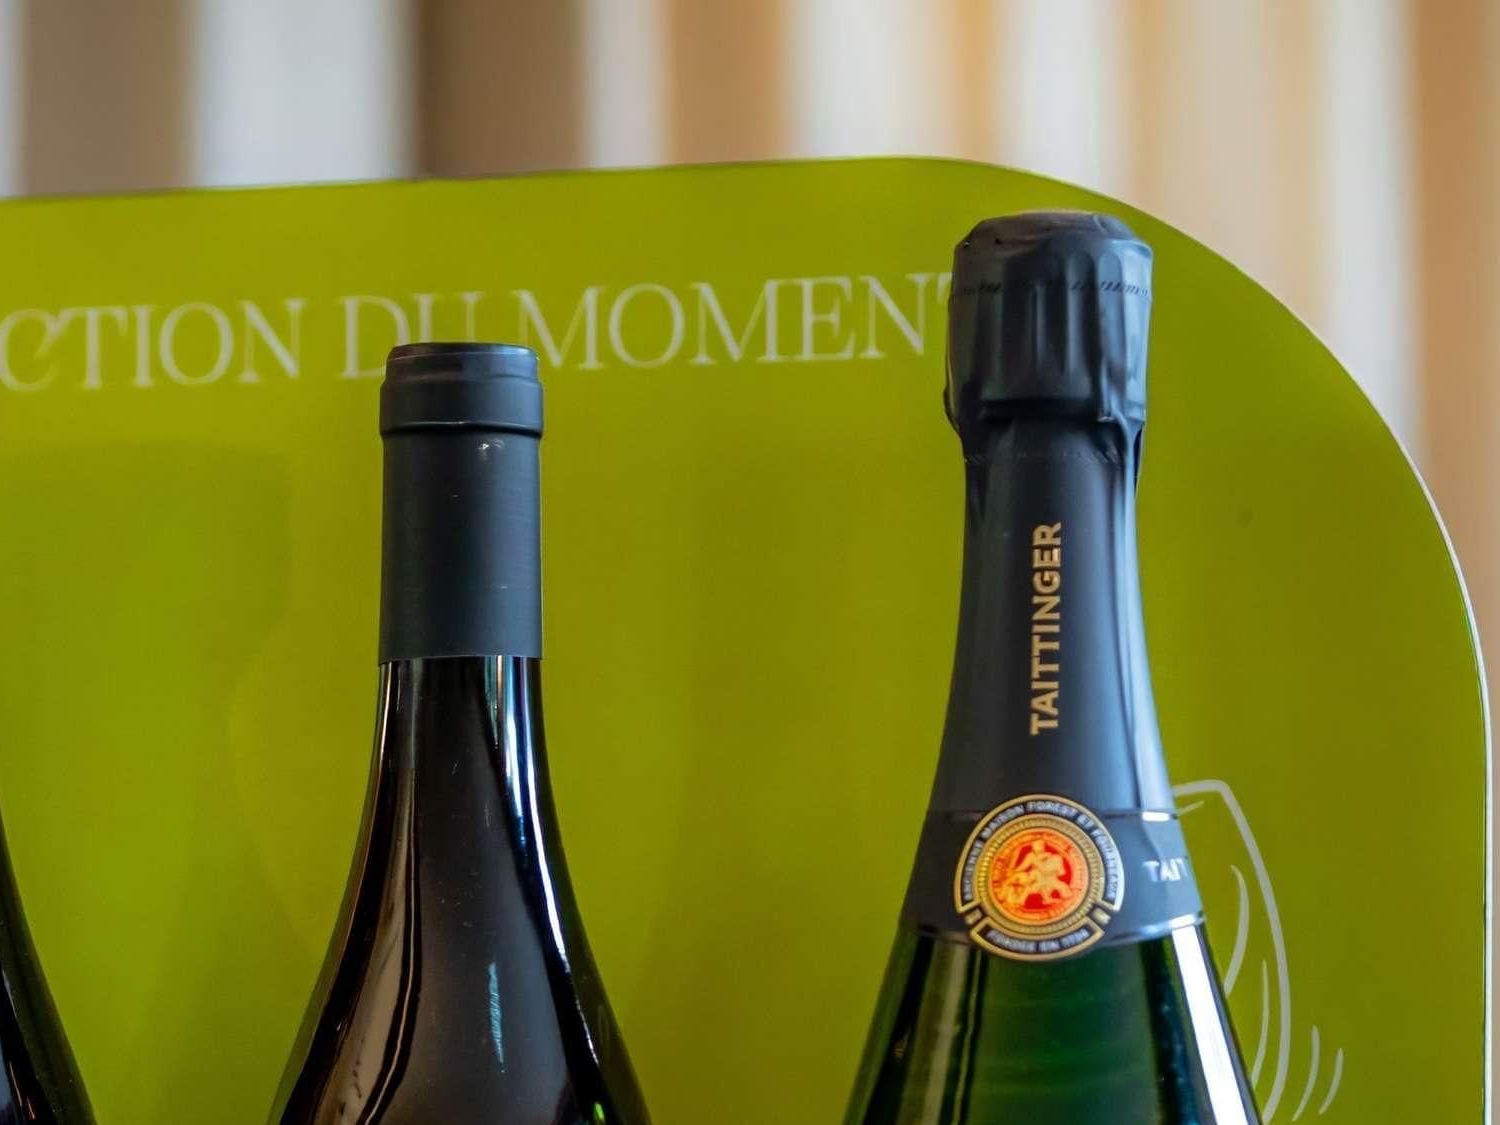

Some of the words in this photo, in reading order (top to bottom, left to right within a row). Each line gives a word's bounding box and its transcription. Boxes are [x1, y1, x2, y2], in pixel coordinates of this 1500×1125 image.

[338, 290, 484, 379] DU
[513, 271, 952, 371] MOMEN
[1030, 522, 1062, 735] TAITTINGER
